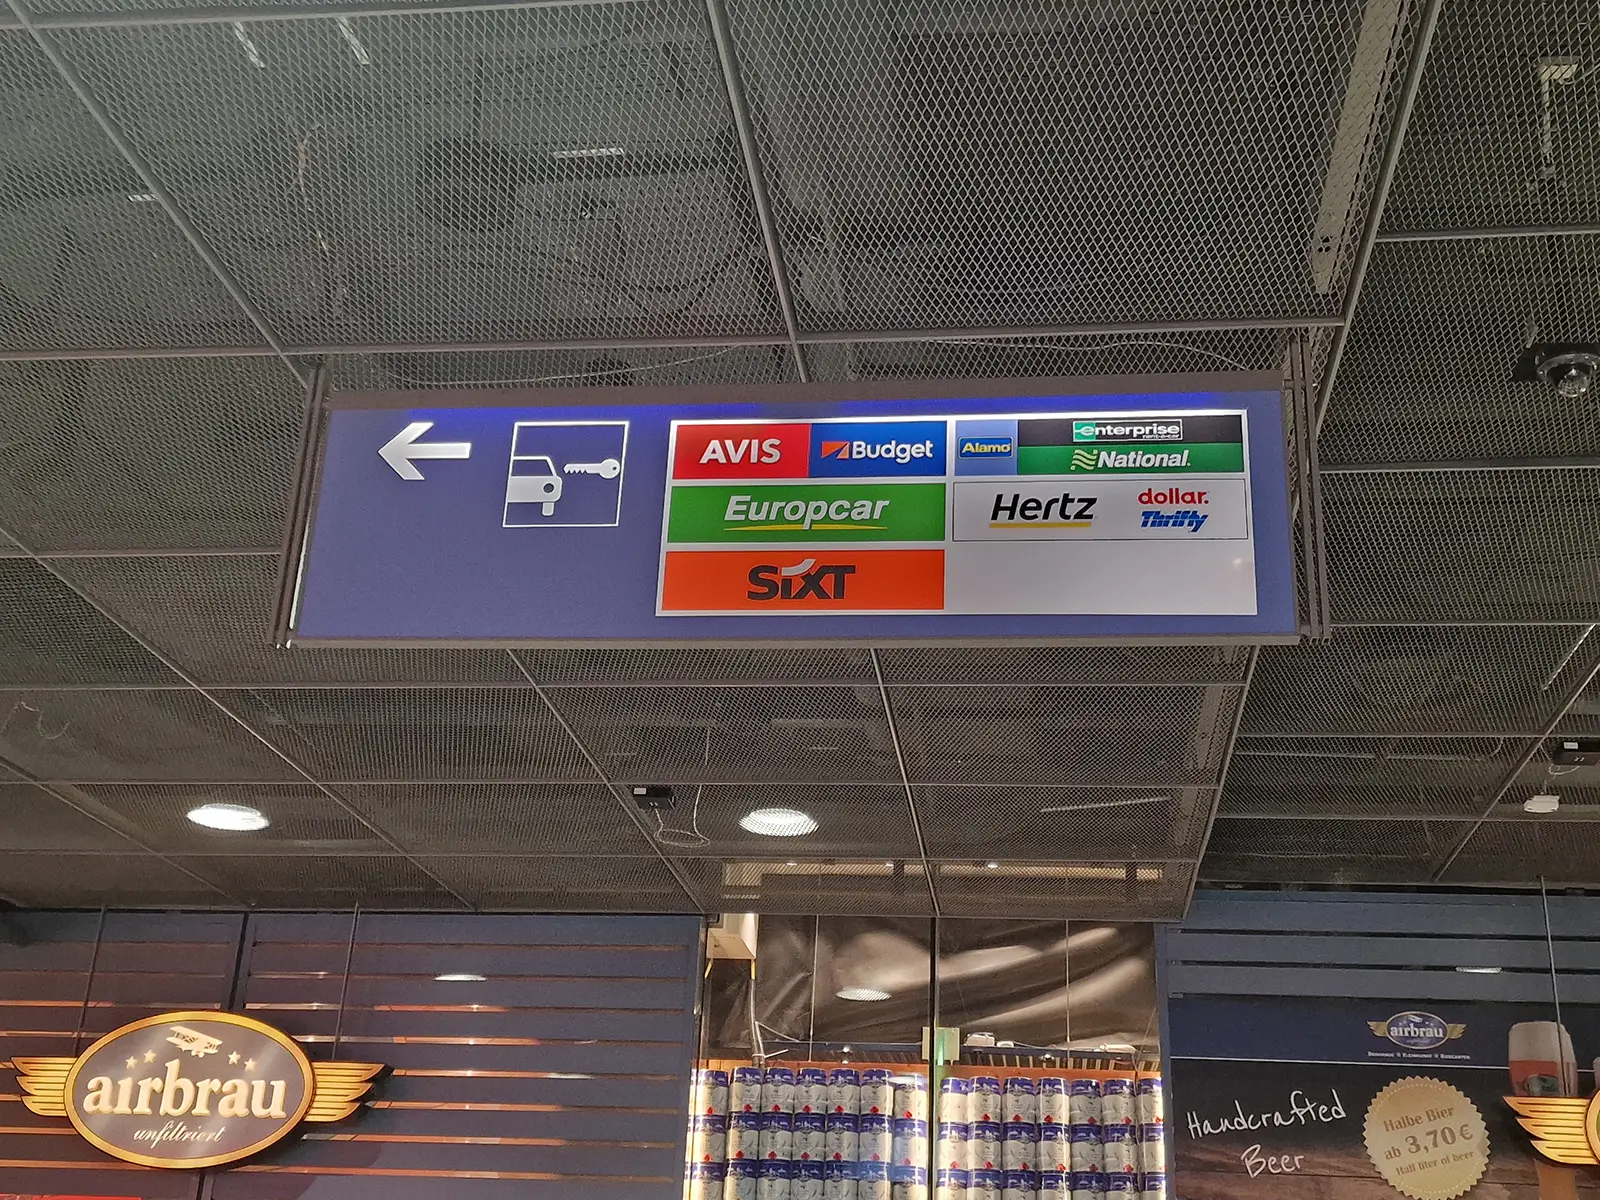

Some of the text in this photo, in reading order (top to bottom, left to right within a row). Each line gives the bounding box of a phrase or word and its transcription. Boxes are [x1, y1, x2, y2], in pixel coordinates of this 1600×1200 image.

[1076, 423, 1180, 438] enterprise
[699, 438, 782, 464] AVIS
[852, 440, 934, 464] Budget
[961, 442, 1011, 453] Alamo
[723, 495, 890, 531] Europcar
[990, 493, 1098, 521] Hertz
[1140, 510, 1209, 533] Thrifty
[1186, 1088, 1347, 1140] Handcrafted
[1383, 1106, 1455, 1133] Halbe Bier
[132, 1119, 227, 1149] unfiltriert
[1240, 1143, 1305, 1179] Beer
[1384, 1145, 1402, 1161] ab
[1395, 1150, 1475, 1176] Half liter of beer
